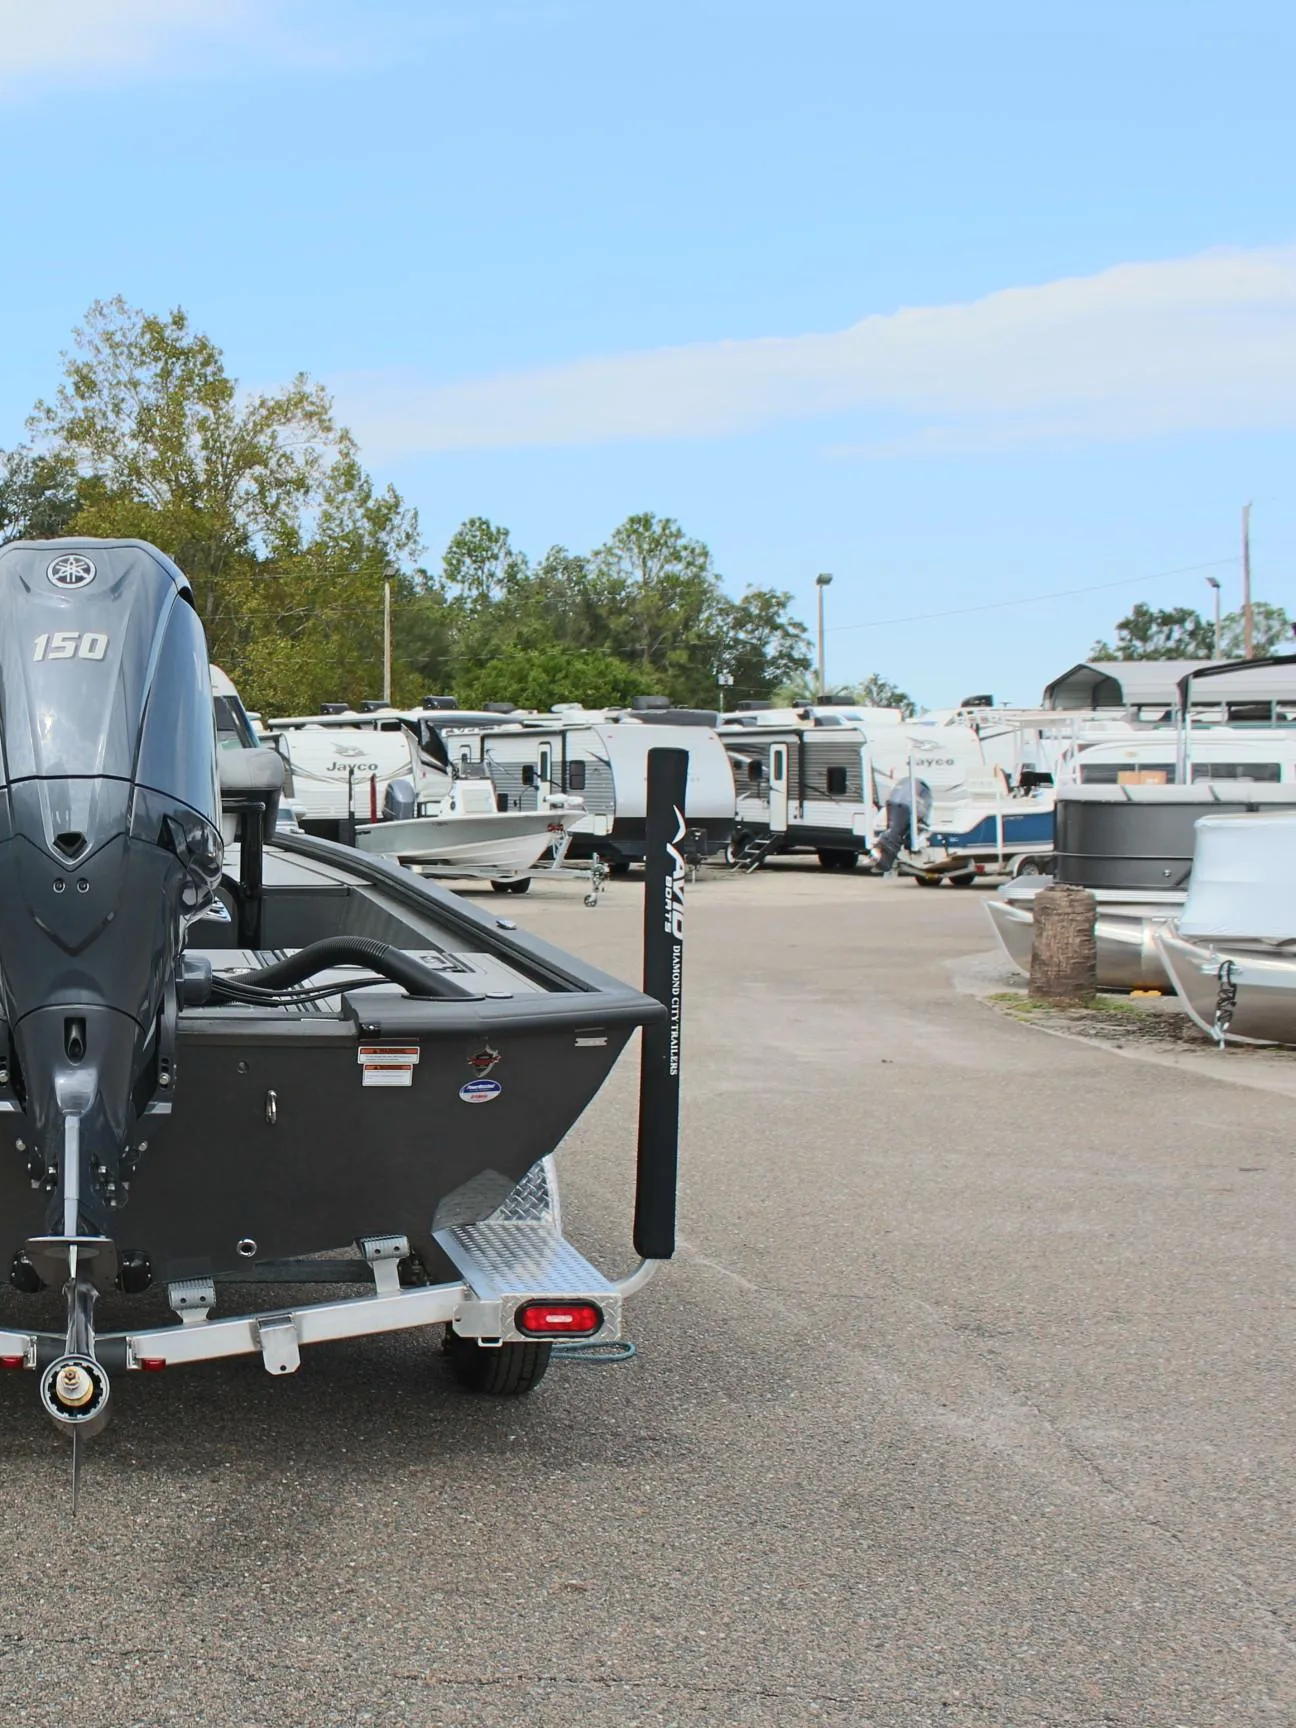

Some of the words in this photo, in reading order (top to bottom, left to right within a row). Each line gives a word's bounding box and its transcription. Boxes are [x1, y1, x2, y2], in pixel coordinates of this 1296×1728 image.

[32, 632, 110, 662] 150
[326, 762, 378, 772] Jayco
[906, 757, 954, 766] ayco
[664, 875, 672, 933] BOATS
[666, 842, 685, 940] AVID
[672, 945, 681, 995] DIAMOND
[671, 997, 680, 1022] CITY
[669, 1023, 679, 1075] TRAILERS
